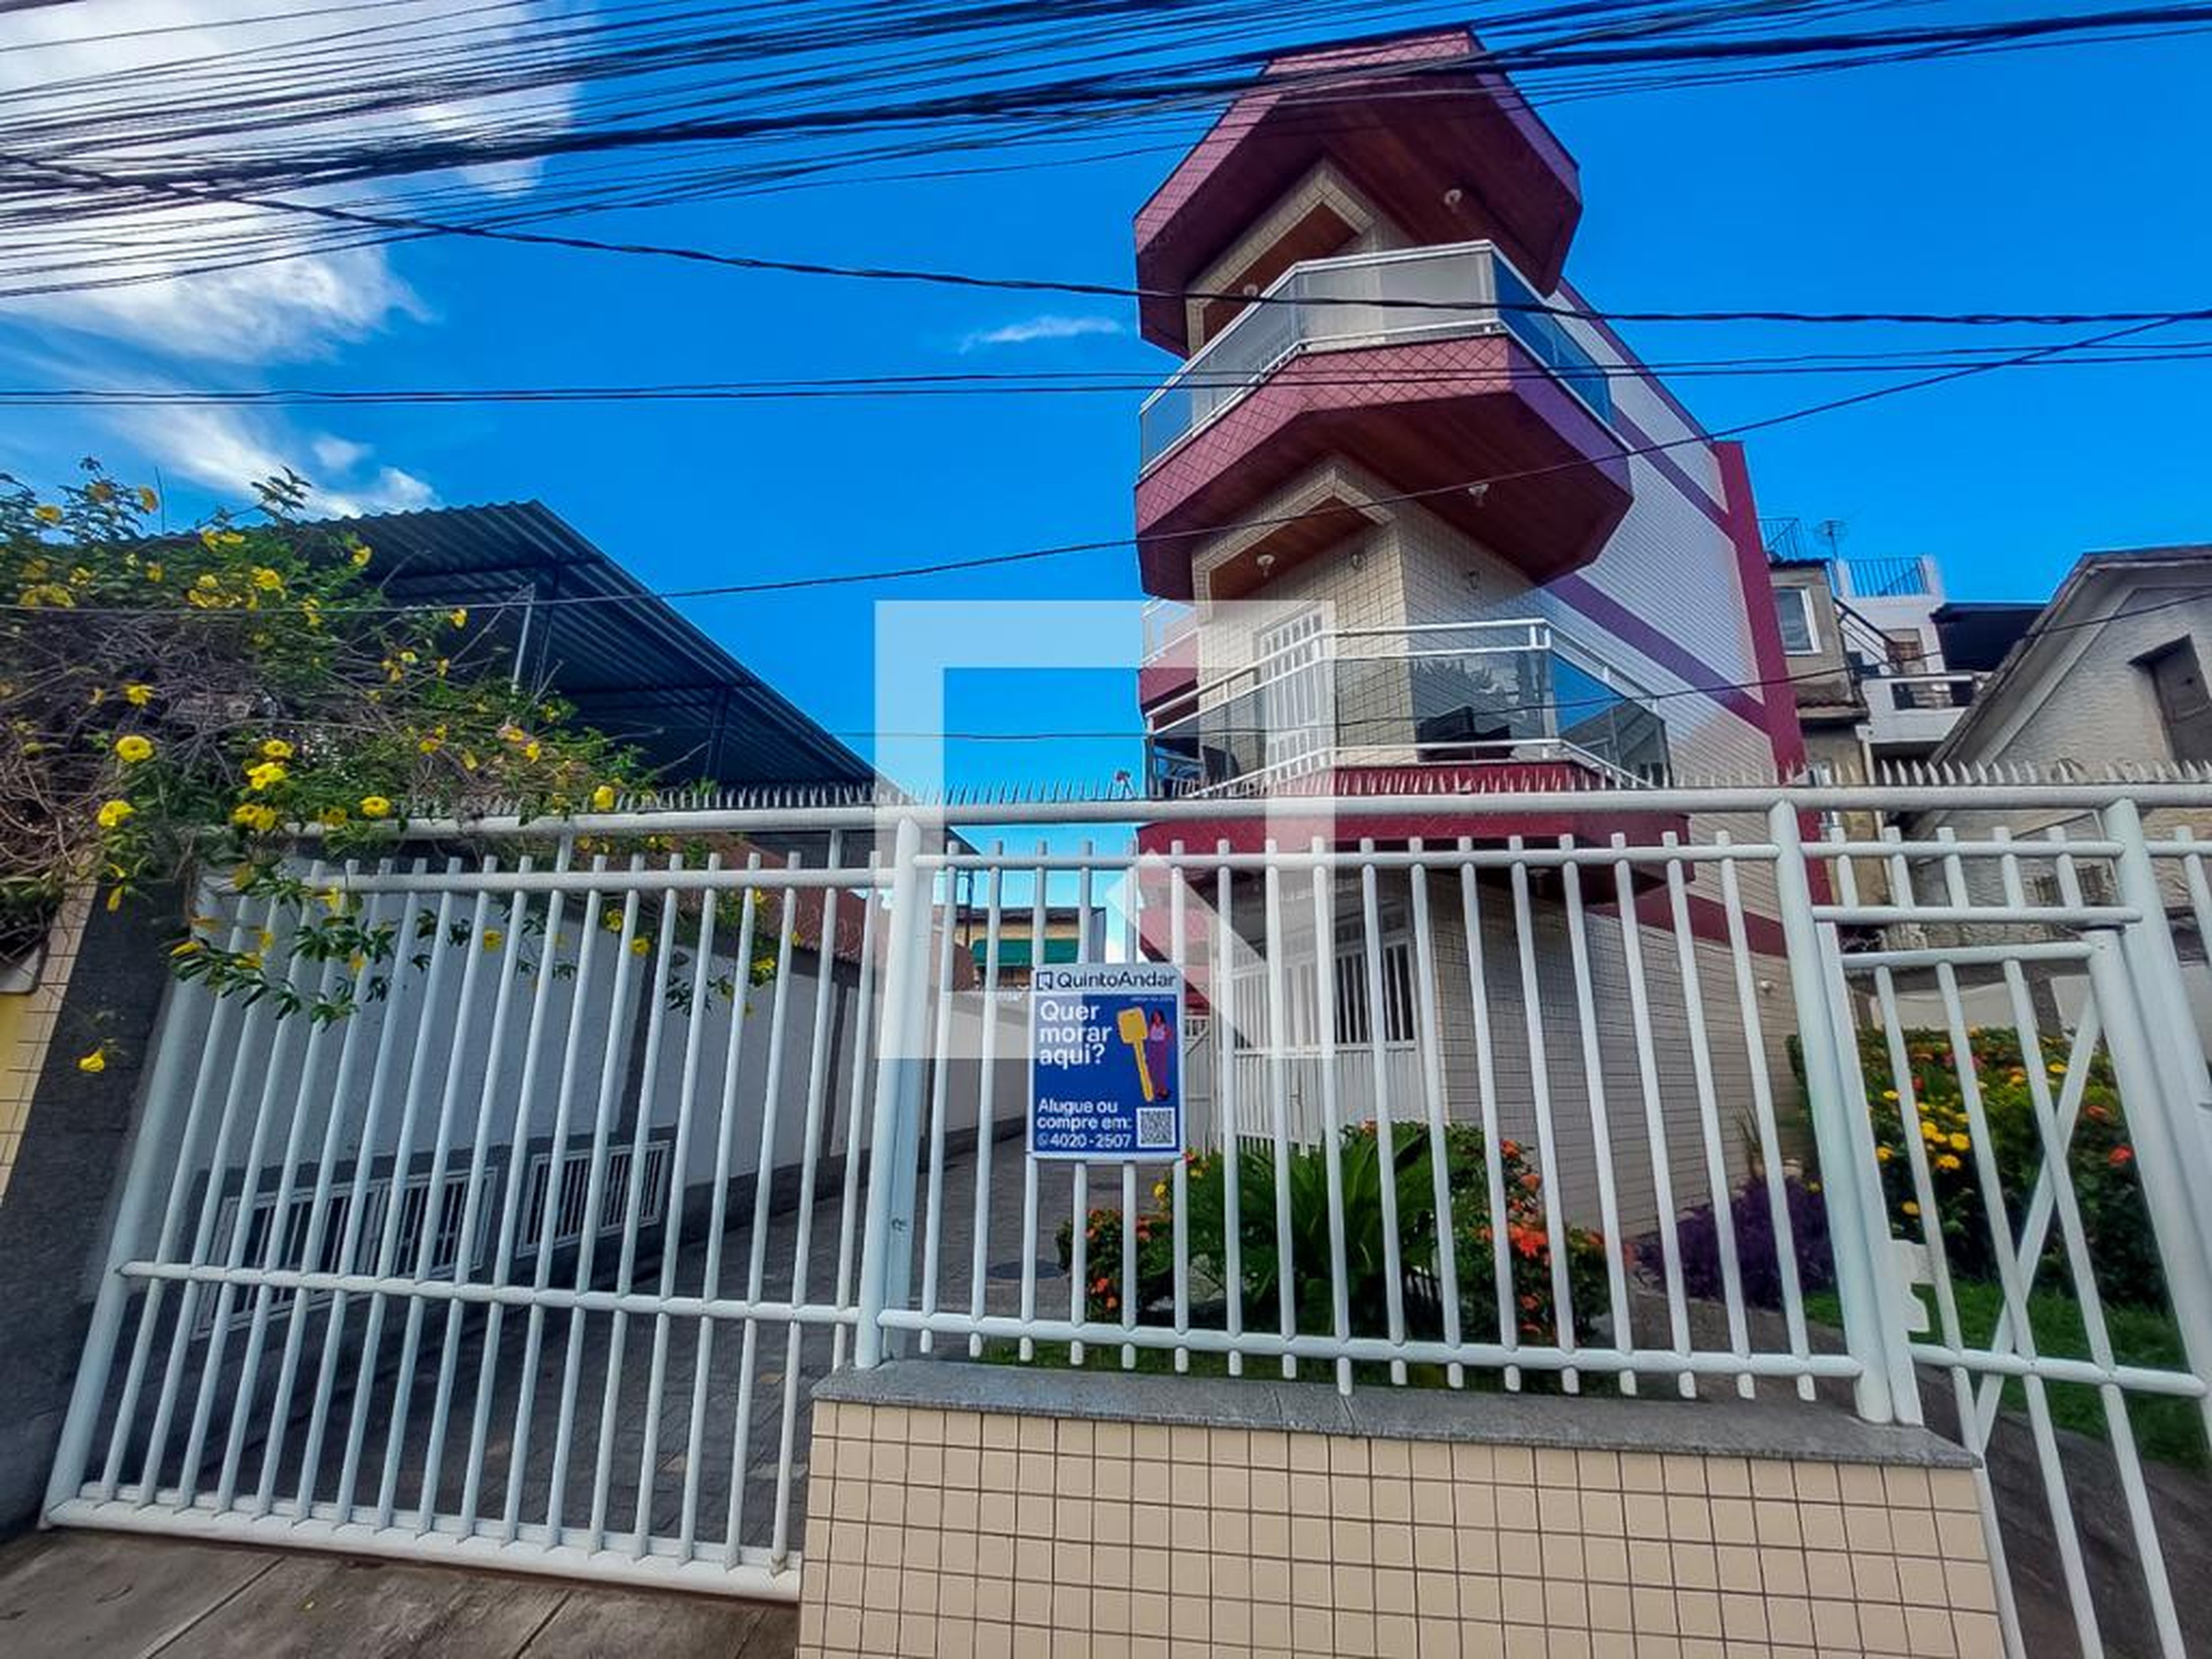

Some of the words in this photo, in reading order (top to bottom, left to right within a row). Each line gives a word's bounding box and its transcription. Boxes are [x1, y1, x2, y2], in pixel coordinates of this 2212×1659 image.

[1057, 971, 1176, 988] QuintoAndar
[1040, 1000, 1100, 1022] Quer
[1040, 1027, 1112, 1043] morar
[1040, 1043, 1105, 1070] aqui?
[1038, 1098, 1093, 1116] Alugue
[1097, 1101, 1118, 1113] ou
[1037, 1116, 1099, 1132] compre
[1101, 1117, 1132, 1130] em:
